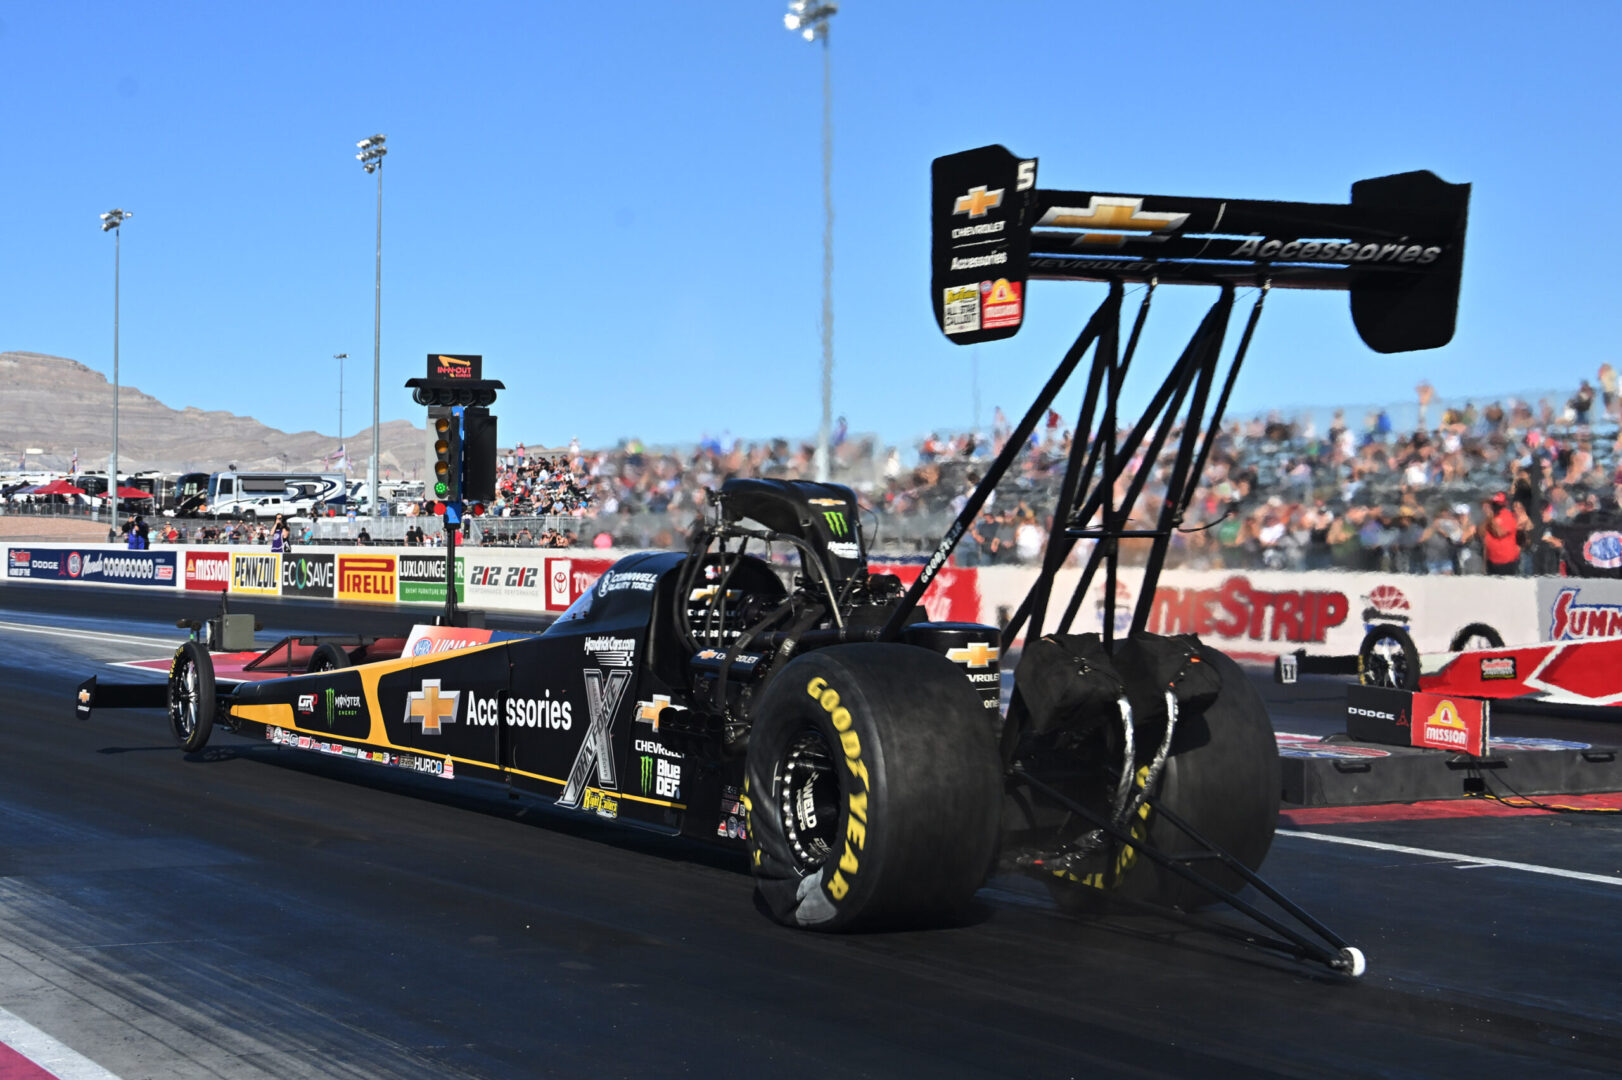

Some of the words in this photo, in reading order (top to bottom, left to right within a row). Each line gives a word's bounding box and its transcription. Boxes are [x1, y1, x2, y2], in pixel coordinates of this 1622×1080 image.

[1016, 161, 1035, 190] 5
[952, 221, 1006, 239] CHEVROLET
[1231, 232, 1442, 263] Accessories
[951, 250, 1008, 271] Accessories
[1030, 257, 1161, 272] HEVROLET
[437, 366, 472, 374] IN-N-OUT
[32, 560, 59, 570] DODGE
[103, 559, 153, 577] NATIONALS
[195, 559, 229, 582] MISSION
[234, 557, 278, 588] PENNZOIL
[399, 560, 446, 578] LUXLOUNGE
[339, 558, 395, 595] PIRELLI
[631, 582, 654, 591] TOOLS
[335, 694, 361, 708] MONSTER
[466, 690, 572, 731] Accssories
[1347, 706, 1396, 721] DODGE
[1426, 726, 1467, 745] MISSION
[413, 757, 442, 774] HURCO
[657, 758, 681, 780] Blue
[656, 776, 681, 798] DEF
[807, 676, 870, 901] GOODYEAR
[803, 782, 817, 828] WELD
